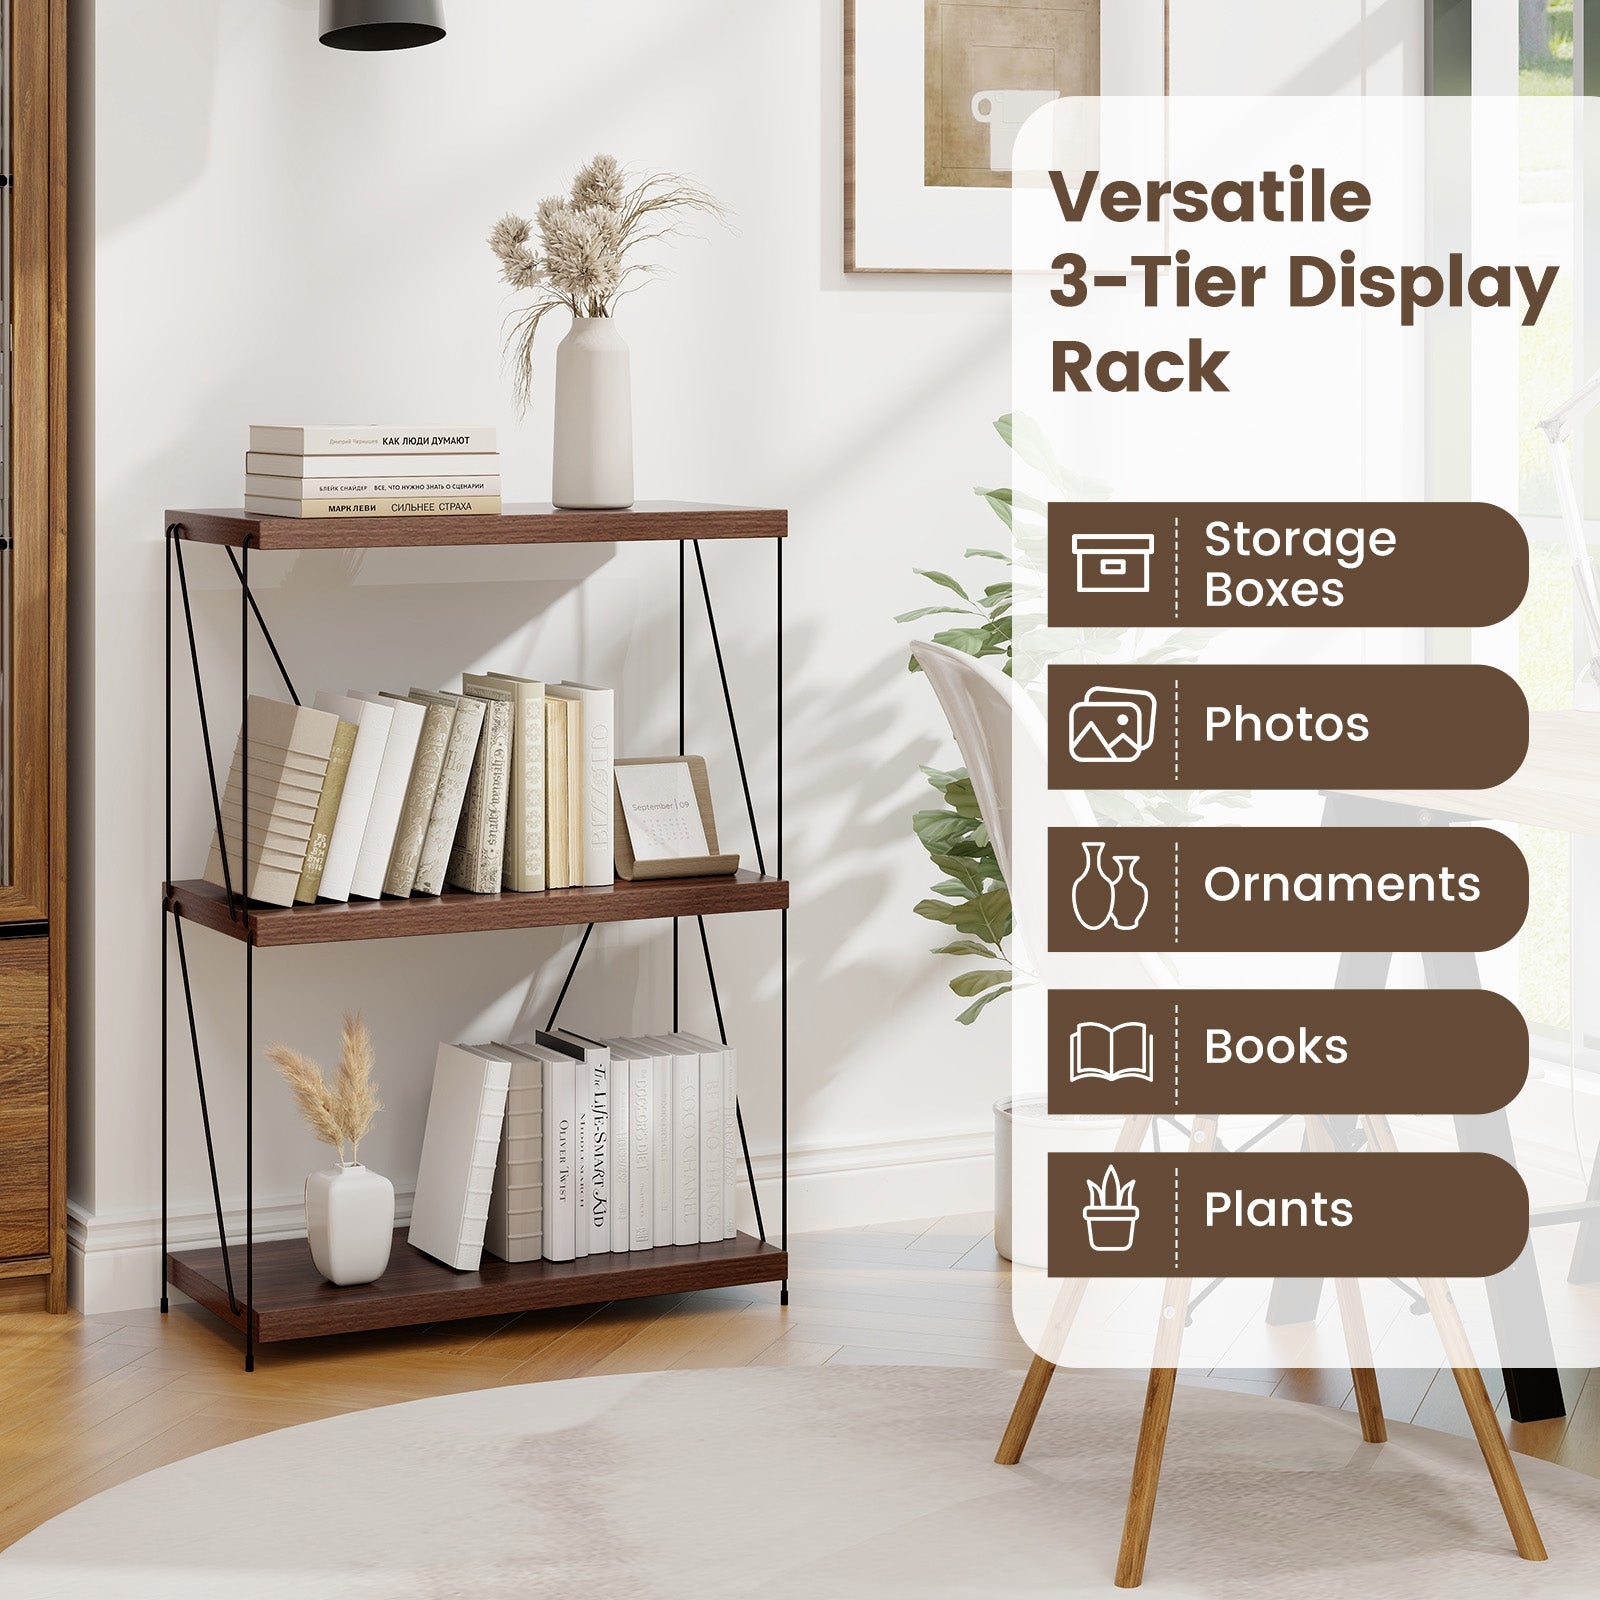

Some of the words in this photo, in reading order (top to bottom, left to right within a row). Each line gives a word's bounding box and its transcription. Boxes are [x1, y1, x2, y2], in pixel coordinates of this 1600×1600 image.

[382, 436, 400, 446] КАК
[401, 436, 430, 447] ЛЮДИ
[431, 436, 470, 447] ДУМАЮТ
[319, 484, 339, 492] БЛЕЙК
[452, 483, 485, 491] СЦЕНАРИИ
[328, 504, 351, 513] МАРК
[352, 504, 377, 513] ЛЕВИ
[391, 503, 435, 513] СИЛЬНЕЕ
[438, 502, 473, 512] СТРАХА
[632, 801, 674, 812] September
[678, 800, 690, 810] 09
[594, 1063, 607, 1087] The
[559, 1119, 570, 1164] OLIVER
[559, 1165, 570, 1202] TWIST
